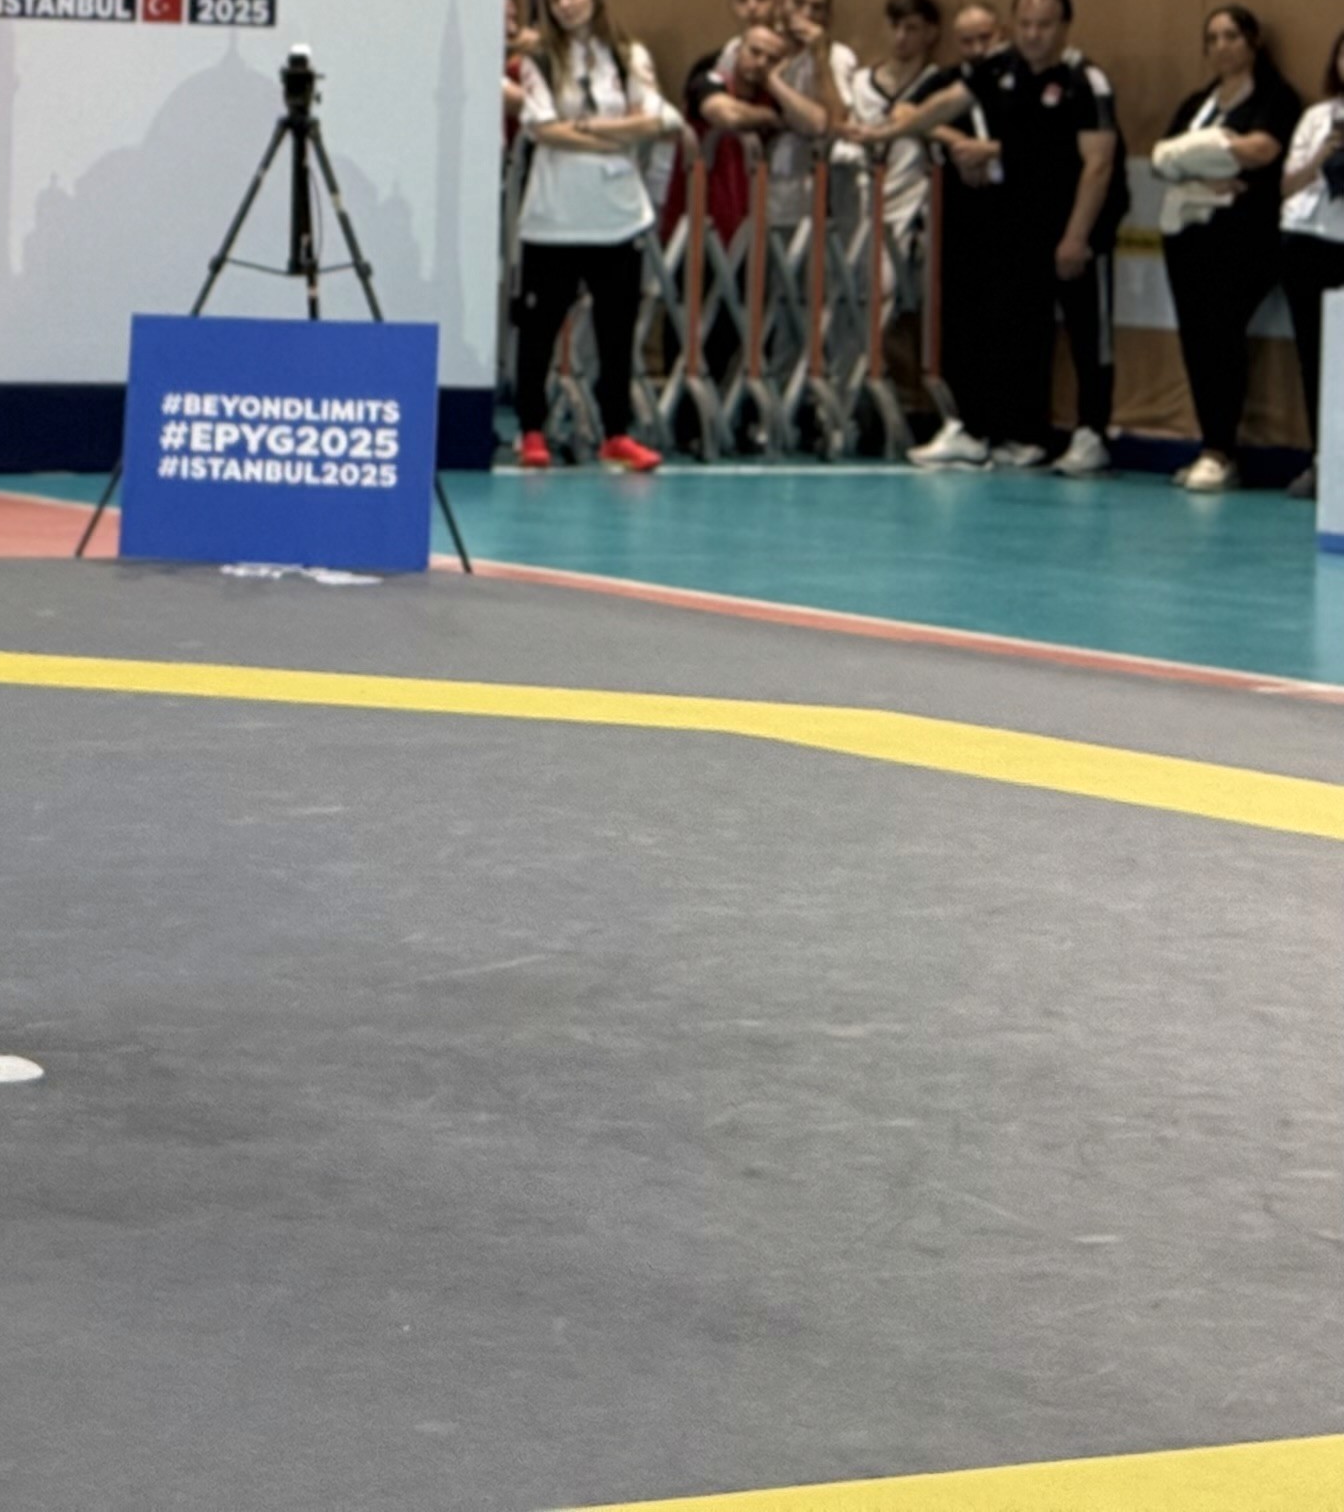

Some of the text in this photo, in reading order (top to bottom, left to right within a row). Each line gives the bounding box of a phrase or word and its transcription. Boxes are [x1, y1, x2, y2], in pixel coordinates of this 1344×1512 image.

[160, 392, 401, 425] #BEYONDLIMITS
[159, 420, 400, 459] #EPYG2025
[158, 455, 398, 489] #ISTANBUL2025
